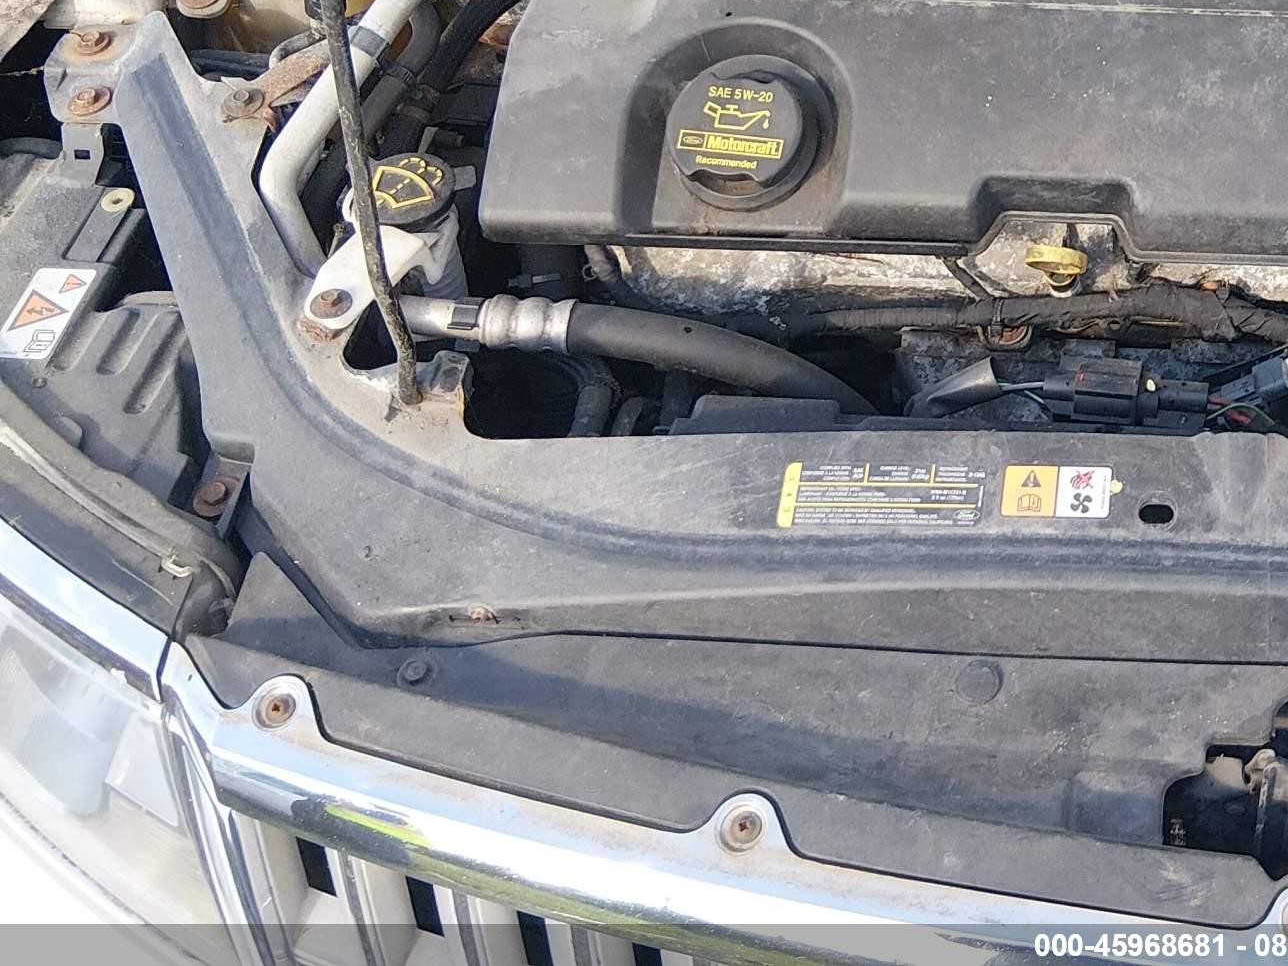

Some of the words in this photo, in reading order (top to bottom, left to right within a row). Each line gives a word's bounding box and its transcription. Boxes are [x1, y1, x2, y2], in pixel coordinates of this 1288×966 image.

[708, 86, 733, 99] SAE
[733, 88, 774, 103] 5W-20
[706, 135, 777, 155] Motorcraft
[695, 154, 758, 170] Recommended
